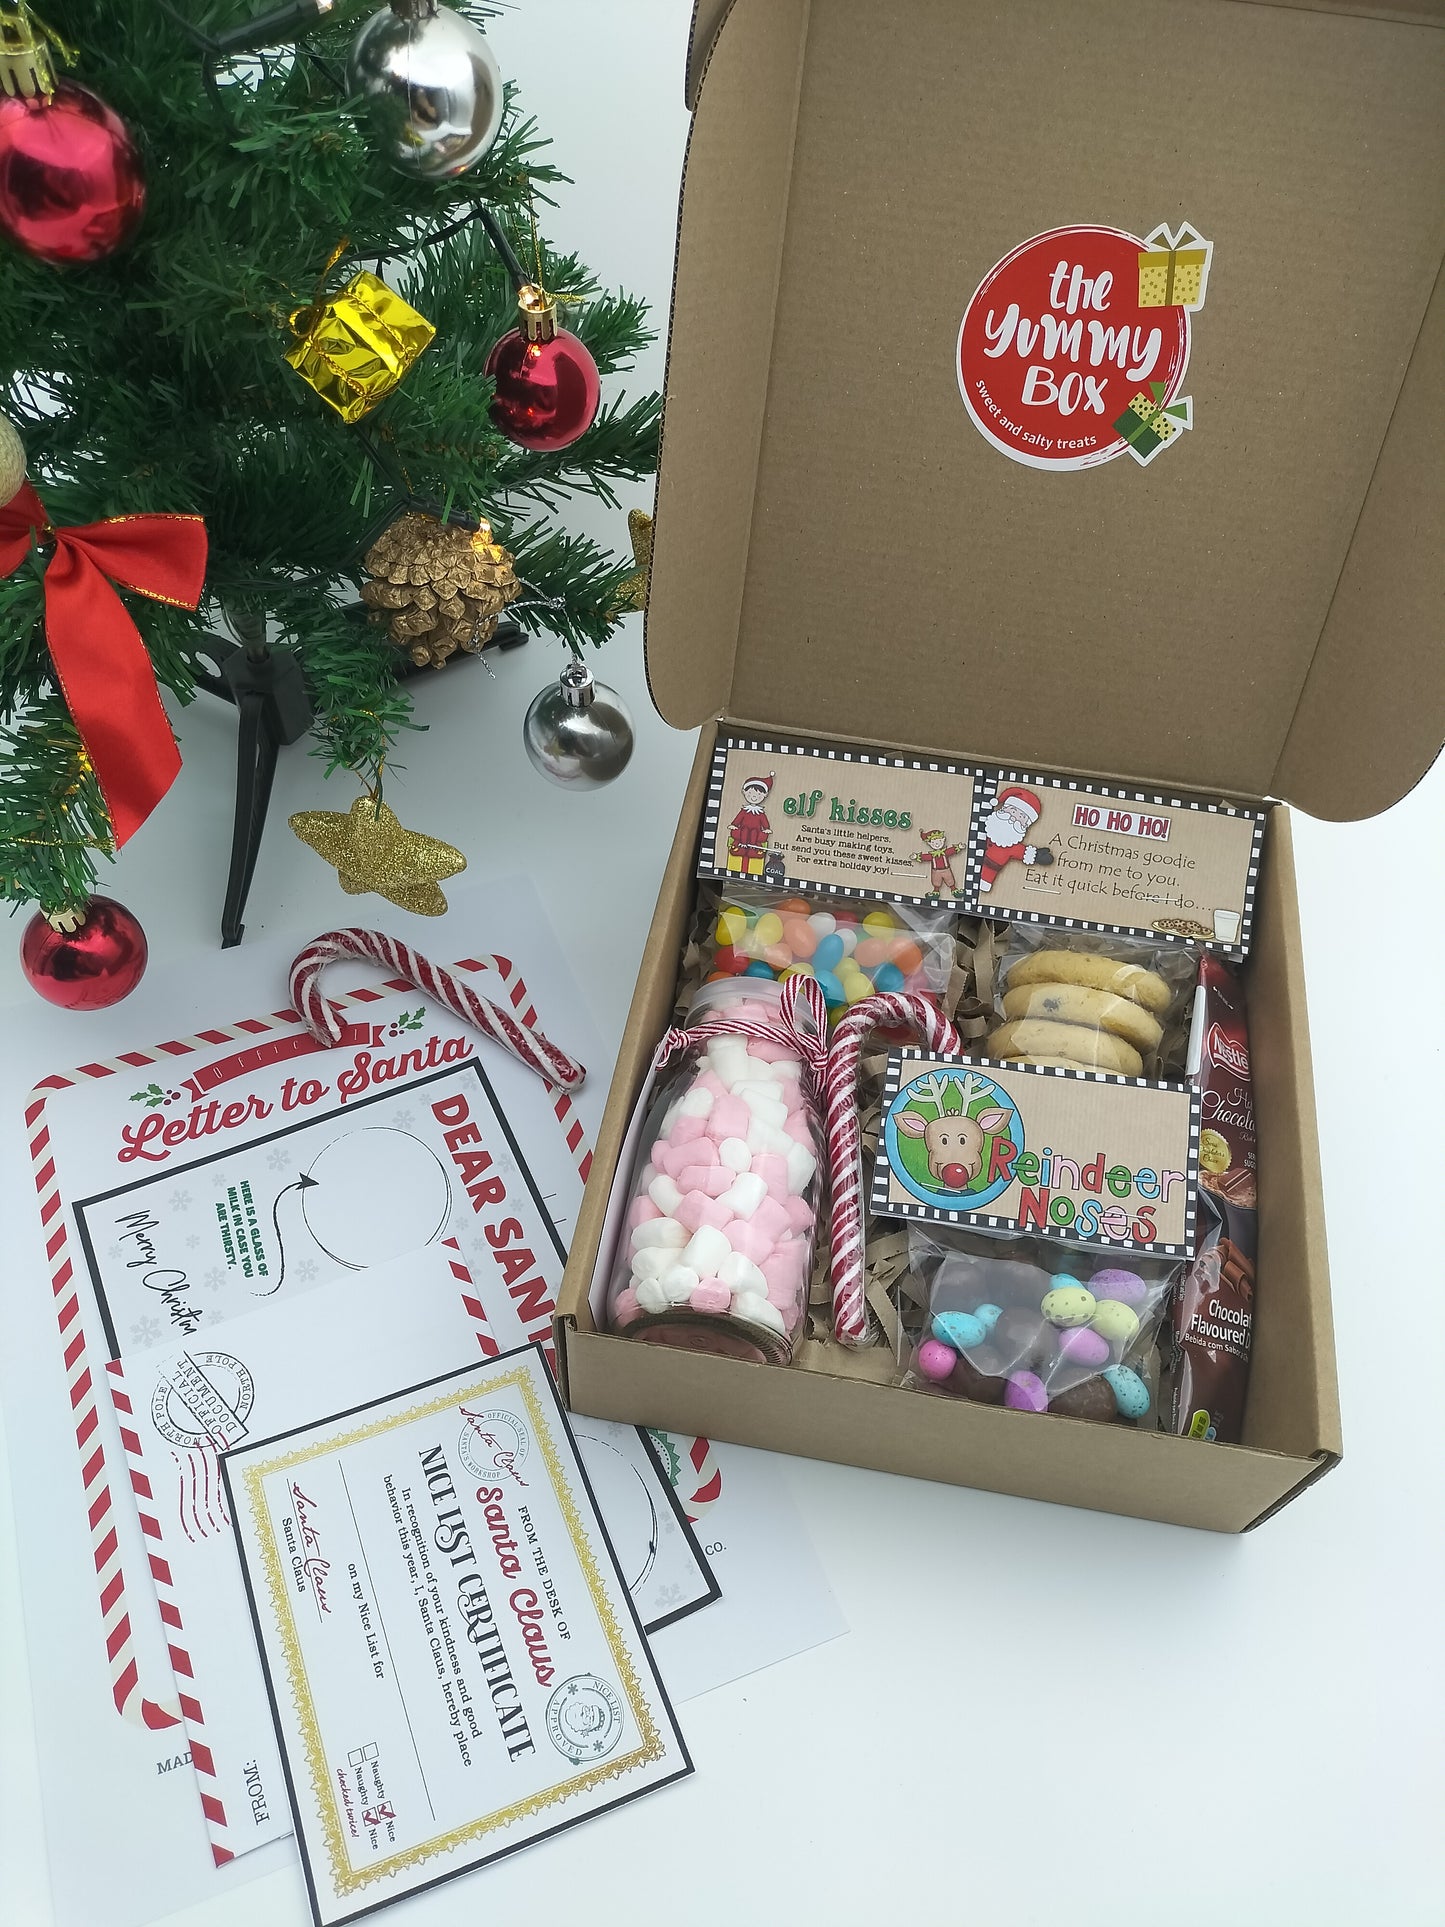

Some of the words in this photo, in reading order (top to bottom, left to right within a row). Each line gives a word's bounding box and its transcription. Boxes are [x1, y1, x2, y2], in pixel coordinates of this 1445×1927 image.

[1049, 261, 1114, 314] the
[976, 380, 1002, 418] sweet
[999, 416, 1022, 436] and
[1022, 431, 1053, 450] salty
[1056, 434, 1097, 449] treats
[783, 790, 823, 817] elf
[828, 797, 912, 830] kisses
[1074, 806, 1100, 827] HO
[1106, 811, 1132, 832] HO
[1138, 816, 1171, 838] HO!
[796, 835, 812, 844] Are
[815, 836, 837, 847] busy
[838, 840, 871, 852] making
[801, 825, 831, 836] Santa's
[834, 829, 855, 839] little
[773, 842, 789, 850] But
[791, 845, 811, 854] send
[813, 848, 831, 857] you
[833, 850, 855, 860] these
[858, 854, 883, 863] sweet
[796, 855, 811, 864] For
[813, 858, 837, 867] extra
[839, 860, 872, 873] holiday
[1049, 833, 1062, 846] A
[1067, 835, 1139, 860] Christmas
[1143, 850, 1196, 869] goodie
[766, 867, 784, 876] COAL
[1056, 851, 1093, 873] from
[1099, 863, 1121, 877] me
[1126, 867, 1143, 880] to
[1146, 871, 1180, 887] you.
[1025, 869, 1047, 885] Eat
[1052, 872, 1063, 887] it
[1067, 878, 1108, 896] quick
[1113, 884, 1160, 904] before
[118, 1094, 274, 1162] Letter
[280, 1078, 330, 1111] to
[337, 1035, 474, 1103] Santa
[431, 1093, 507, 1214] DEAR
[987, 1136, 1186, 1203] Reindeer
[227, 1186, 241, 1213] MILK
[240, 1180, 253, 1205] HERE
[215, 1202, 228, 1222] ARE
[232, 1213, 244, 1227] IN
[245, 1206, 256, 1217] IS
[248, 1218, 257, 1227] A
[114, 1209, 160, 1268] Merry
[220, 1222, 237, 1270] THIRSTY.
[236, 1228, 249, 1255] CASE
[250, 1227, 265, 1261] GLASS
[241, 1255, 254, 1278] YOU
[257, 1262, 269, 1277] OF
[1185, 1332, 1206, 1347] Bebida
[1208, 1341, 1224, 1350] com
[1191, 1313, 1246, 1346] Flavoured
[206, 1355, 237, 1370] POLE
[154, 1386, 168, 1419] POLE
[172, 1370, 222, 1435] OFFICIAL
[177, 1359, 238, 1434] DOCUMENT
[236, 1368, 251, 1410] NORTH
[160, 1422, 201, 1445] NORTH
[487, 1412, 519, 1428] OFFICIAL
[517, 1427, 526, 1445] SEAL
[459, 1406, 503, 1450] Santa
[493, 1451, 529, 1486] Claus
[519, 1448, 526, 1457] OF
[418, 1443, 457, 1506] NICE
[467, 1461, 501, 1478] WORKSHOP
[383, 1474, 403, 1524] behavior
[402, 1487, 412, 1501] In
[292, 1482, 320, 1556] Santa
[398, 1526, 411, 1550] this
[406, 1503, 430, 1569] recognition
[434, 1506, 477, 1568] LIST
[704, 1541, 727, 1556] CO.
[282, 1517, 297, 1554] Santa
[291, 1556, 306, 1593] Claus
[347, 1563, 358, 1579] on
[402, 1553, 419, 1583] year,
[303, 1558, 332, 1613] Claus
[426, 1571, 438, 1584] of
[476, 1486, 522, 1579] Santa
[509, 1588, 555, 1687] Claus
[518, 1505, 538, 1545] FROM
[532, 1547, 548, 1576] THE
[542, 1578, 564, 1618] DESK
[557, 1621, 571, 1640] OF
[352, 1581, 363, 1600] my
[413, 1585, 424, 1596] I,
[427, 1586, 444, 1614] your
[358, 1602, 371, 1631] Nice
[418, 1598, 435, 1636] Santa
[366, 1632, 378, 1658] List
[430, 1637, 446, 1680] Claus,
[438, 1616, 461, 1675] kindness
[373, 1661, 385, 1679] for
[457, 1573, 536, 1763] CERTIFICATE
[441, 1681, 461, 1727] hereby
[456, 1678, 472, 1703] and
[593, 1681, 613, 1700] NICE
[610, 1700, 620, 1723] LIST
[462, 1707, 483, 1739] good
[550, 1700, 582, 1756] APPROVED
[453, 1730, 472, 1767] place
[243, 1759, 270, 1826] FROM:
[336, 1768, 354, 1806] checked
[371, 1760, 385, 1799] Naughty
[385, 1820, 395, 1842] Nice
[355, 1767, 368, 1806] Naughty
[369, 1828, 379, 1850] Nice
